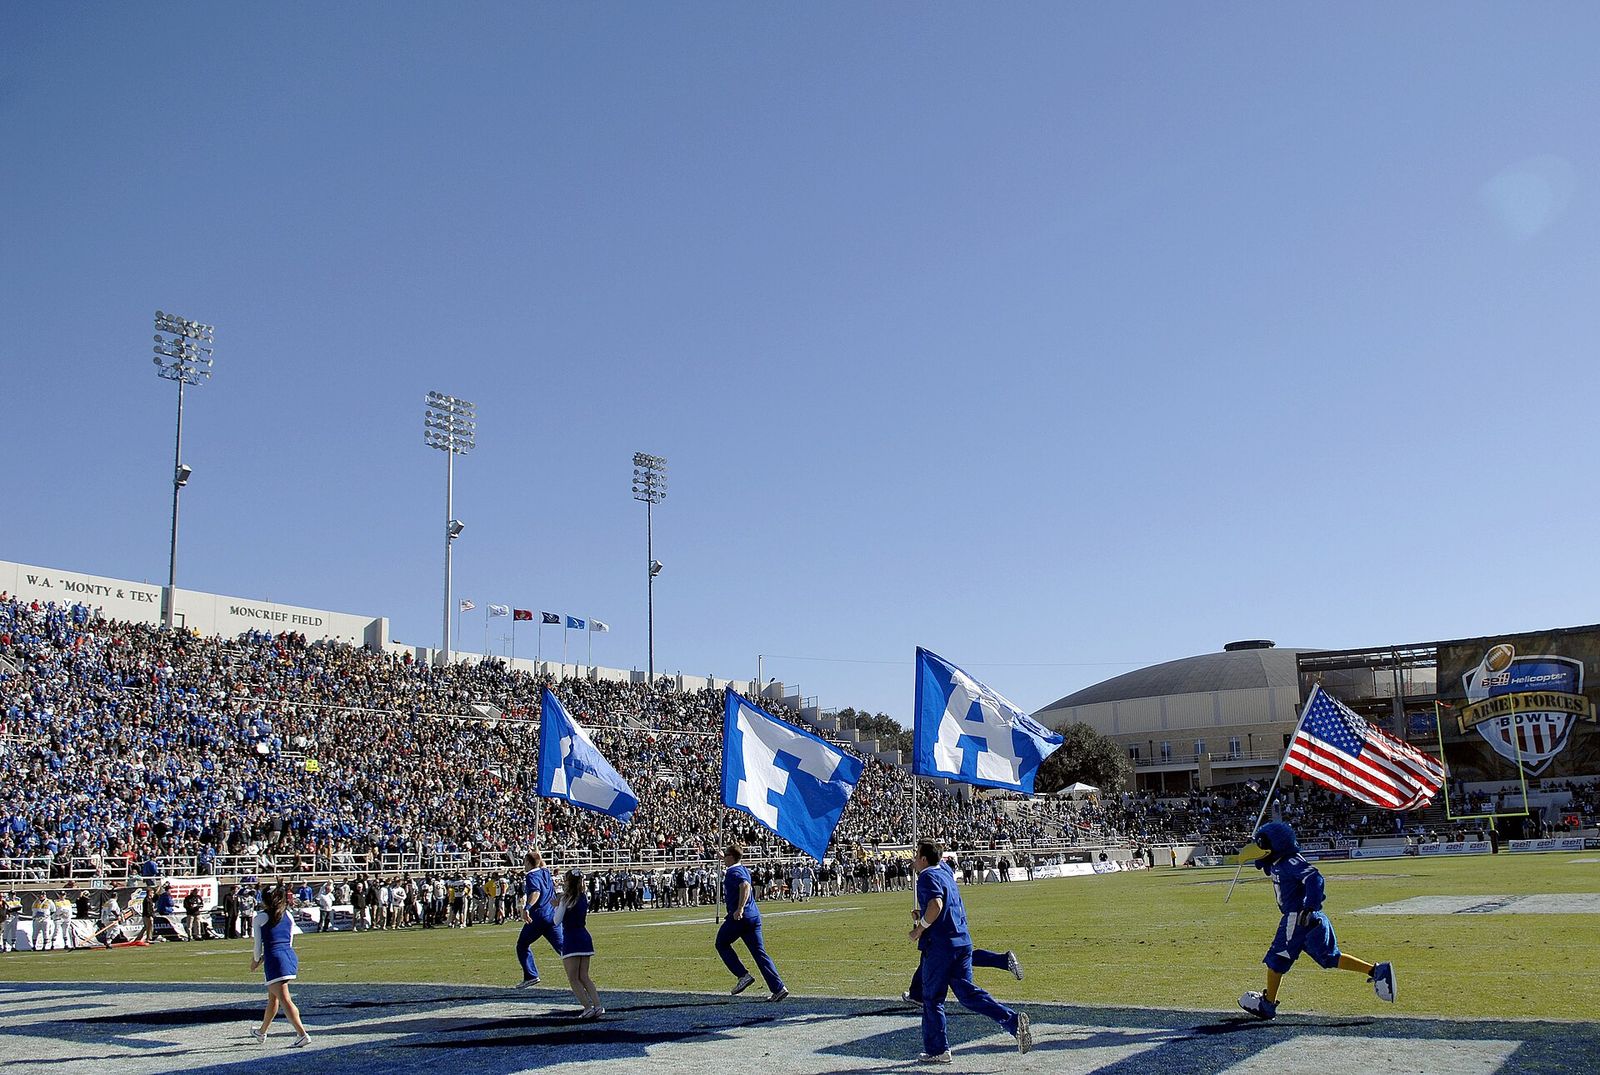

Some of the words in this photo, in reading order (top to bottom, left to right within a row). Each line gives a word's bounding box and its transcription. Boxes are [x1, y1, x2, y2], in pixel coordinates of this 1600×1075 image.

[26, 574, 54, 588] W.A.
[116, 589, 125, 598] &
[229, 605, 288, 622] MONCRIEF
[292, 614, 323, 627] FIELD
[1511, 672, 1567, 685] Helicopter
[1471, 695, 1520, 720] ARMED
[1524, 694, 1584, 712] FORCES
[1500, 713, 1555, 727] BOWL
[736, 702, 843, 831] F
